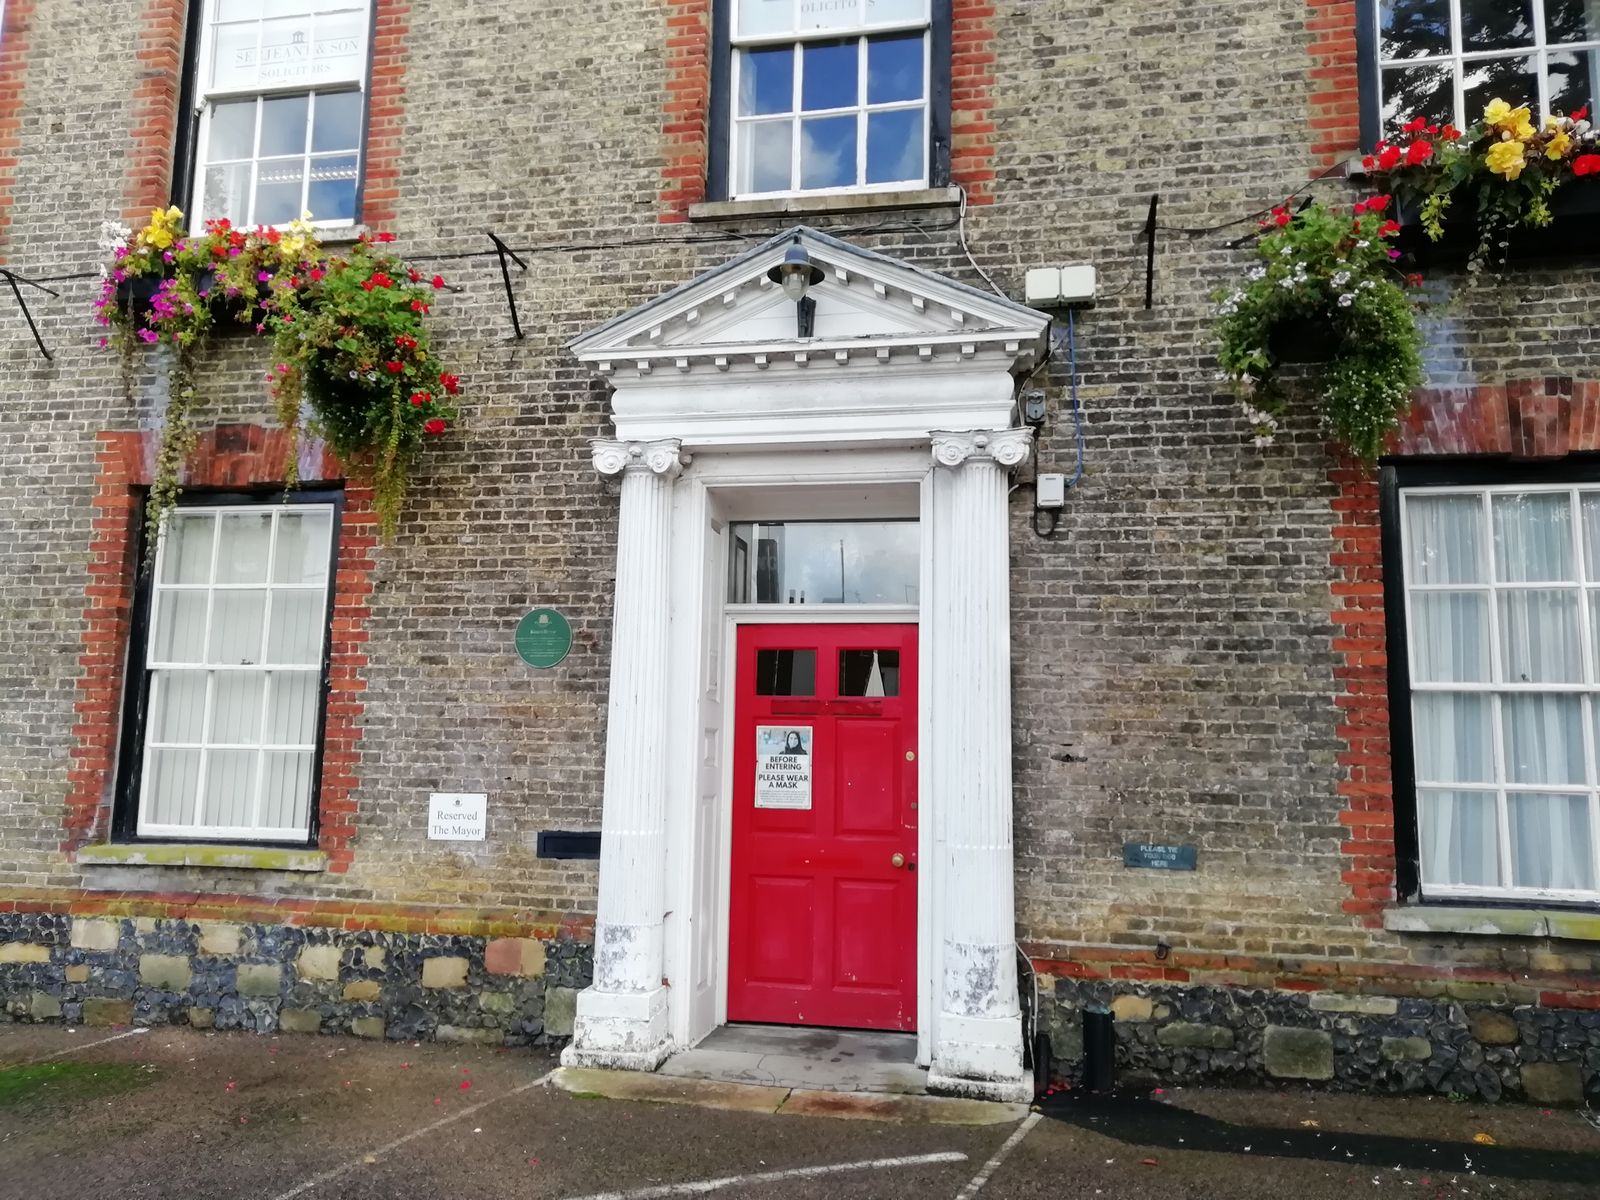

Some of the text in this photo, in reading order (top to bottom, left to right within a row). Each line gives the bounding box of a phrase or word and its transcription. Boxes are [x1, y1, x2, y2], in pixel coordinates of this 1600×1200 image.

[800, 0, 875, 14] OLICITOS
[235, 40, 360, 63] SEJEANT & SON
[437, 810, 478, 821] Reserved
[432, 825, 481, 838] The Mayor
[1140, 845, 1166, 853] PLEASE
[1151, 860, 1169, 868] HERE
